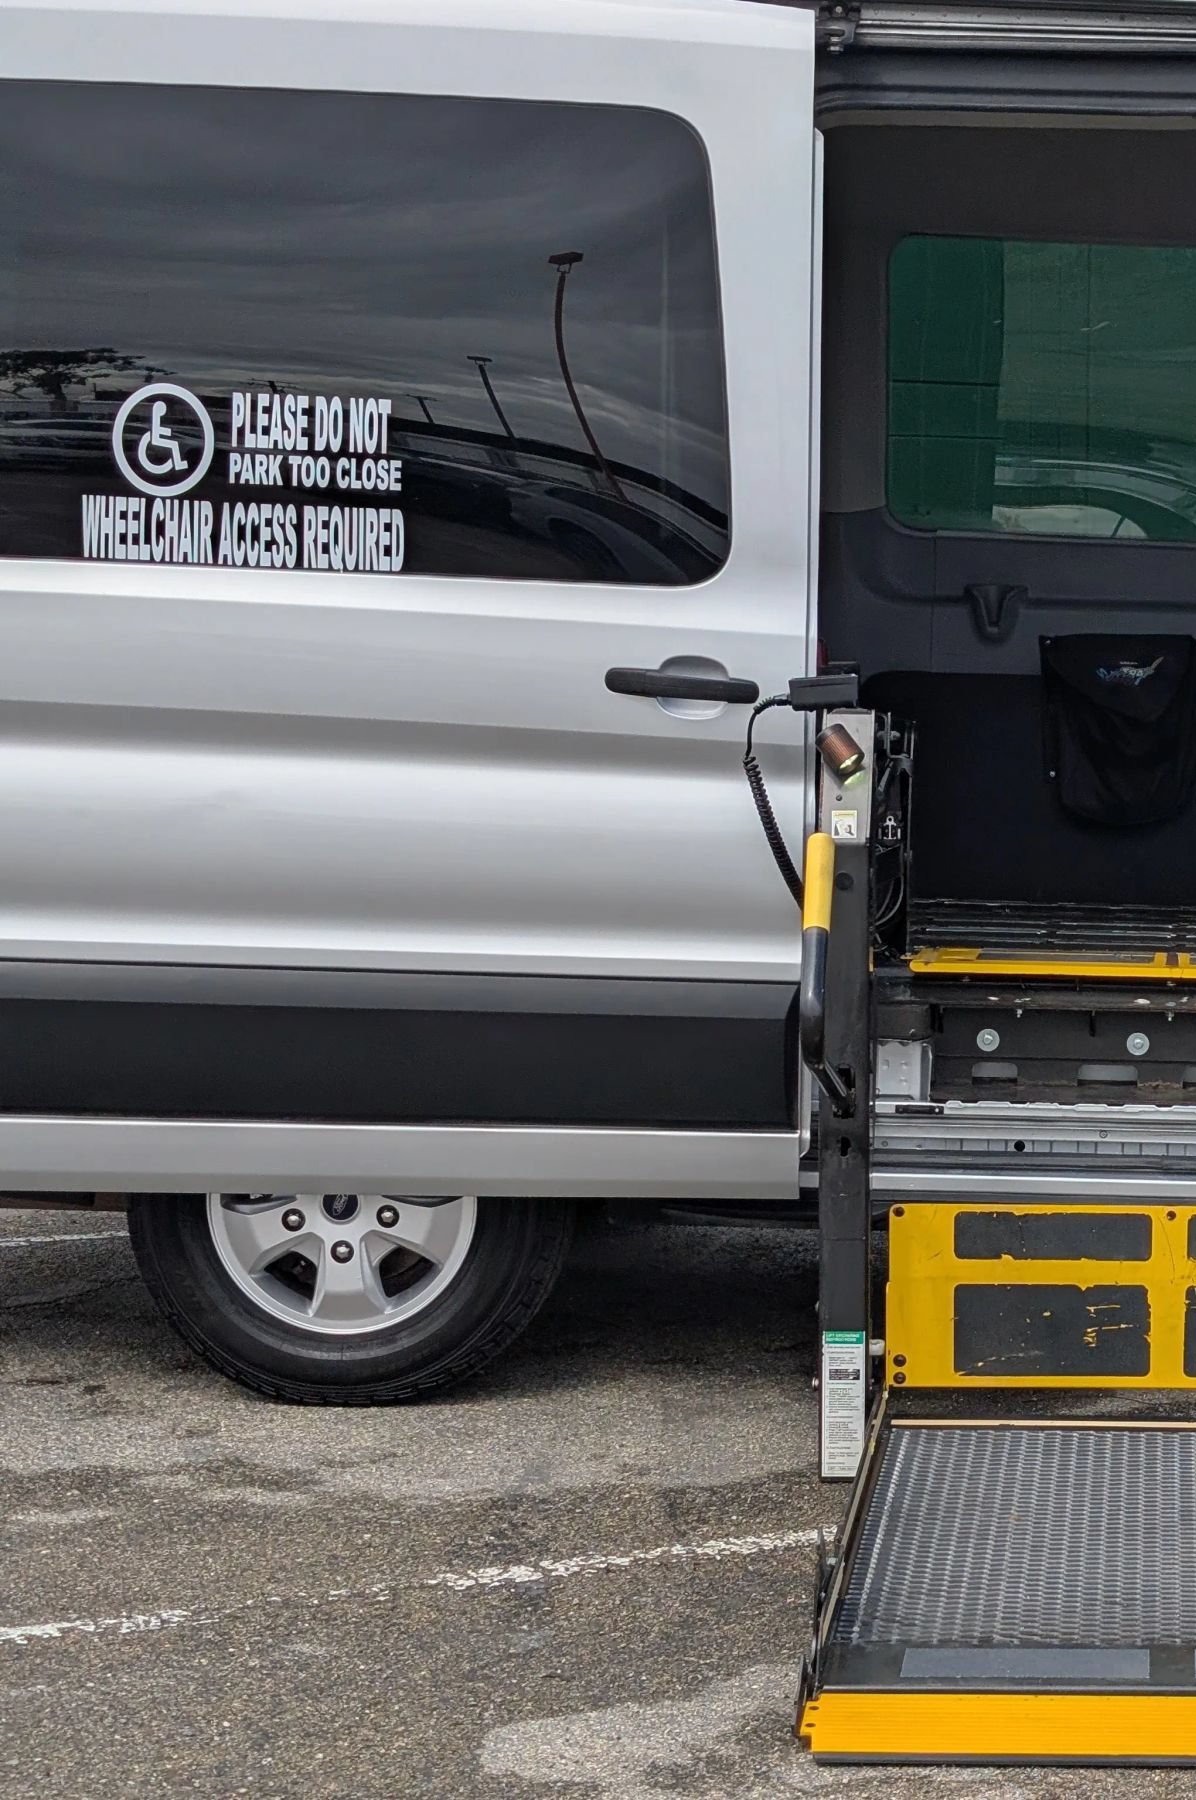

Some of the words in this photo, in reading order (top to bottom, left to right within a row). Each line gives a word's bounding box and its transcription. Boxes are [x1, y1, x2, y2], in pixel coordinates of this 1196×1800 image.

[231, 392, 309, 451] PLEASE
[314, 395, 343, 453] DO
[349, 397, 392, 454] NOT
[229, 453, 283, 486] PARK
[289, 455, 331, 488] TOO
[336, 457, 402, 492] CLOSE
[81, 494, 214, 564] WHEELCHAIR
[218, 502, 298, 568] ACCESS
[303, 505, 405, 574] REQUIRED
